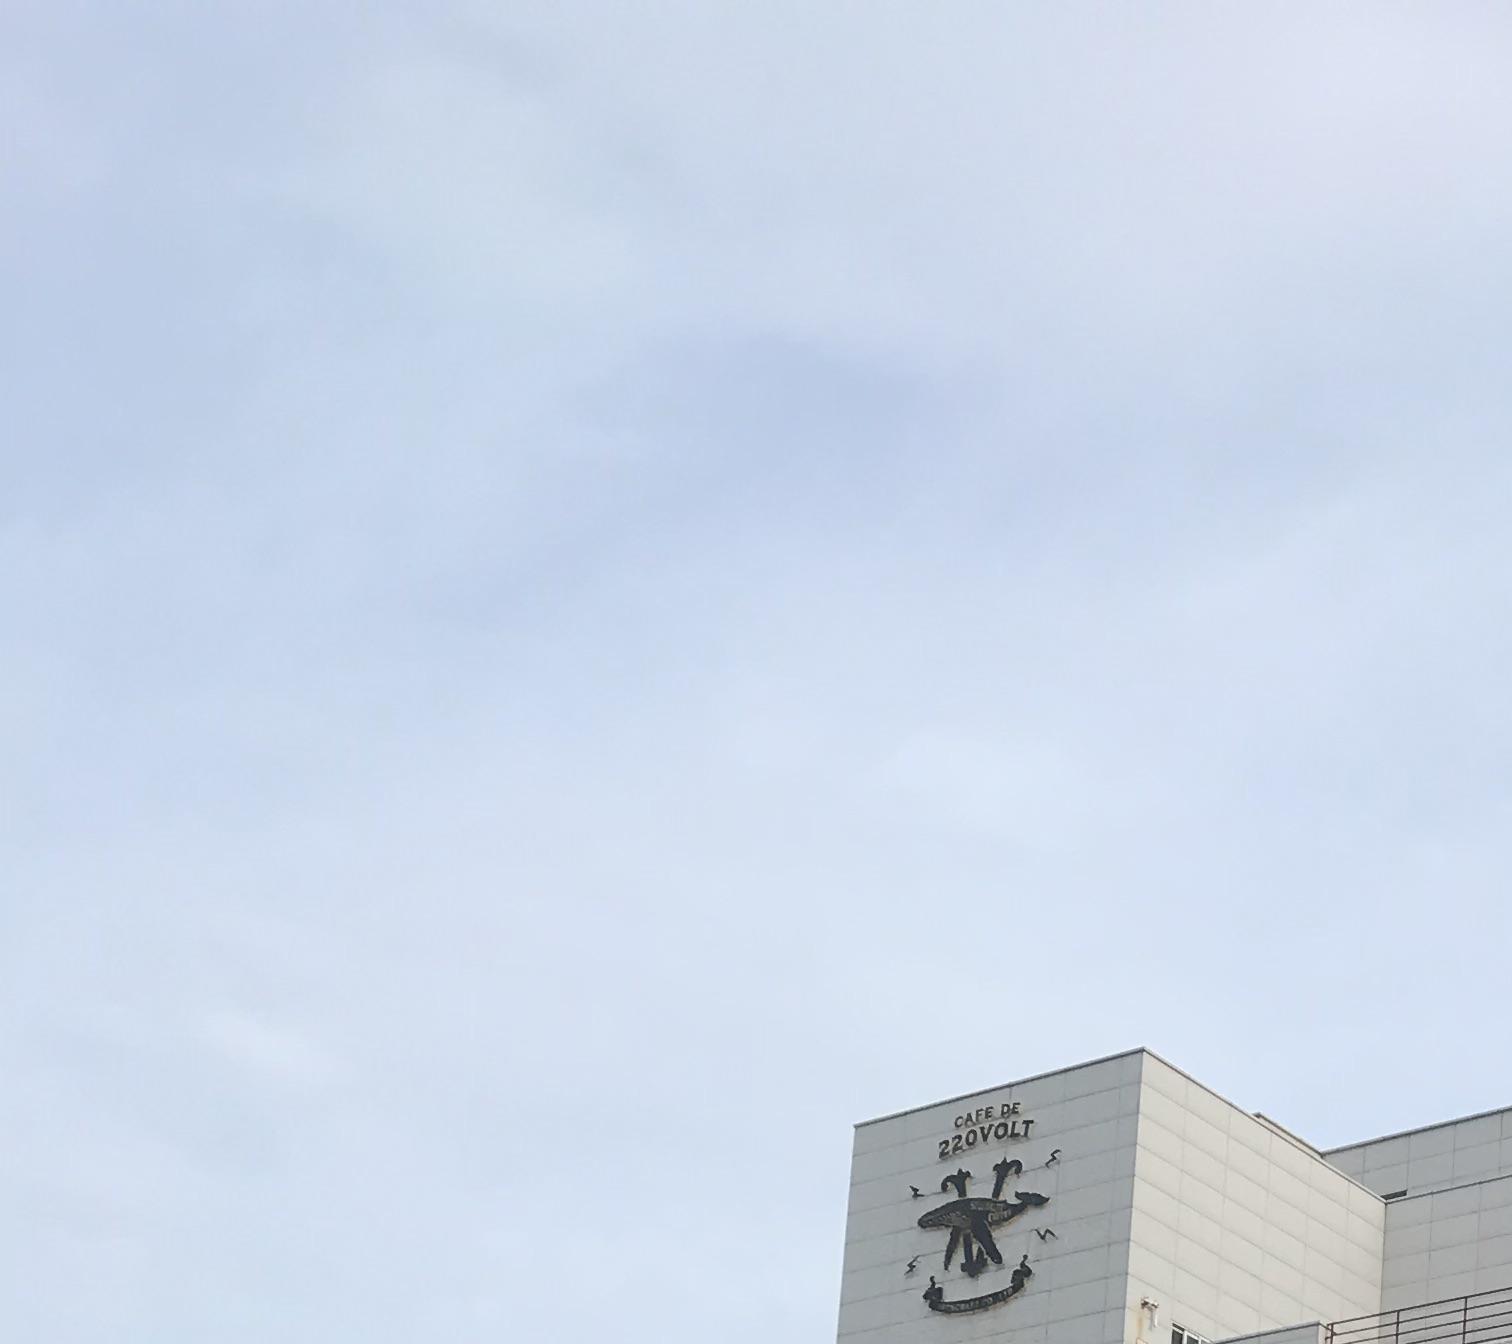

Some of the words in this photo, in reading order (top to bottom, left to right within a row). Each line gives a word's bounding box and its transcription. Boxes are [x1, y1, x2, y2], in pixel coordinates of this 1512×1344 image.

[954, 1106, 994, 1128] CAFE
[1000, 1102, 1021, 1118] DE
[938, 1119, 1035, 1159] 220VOLT
